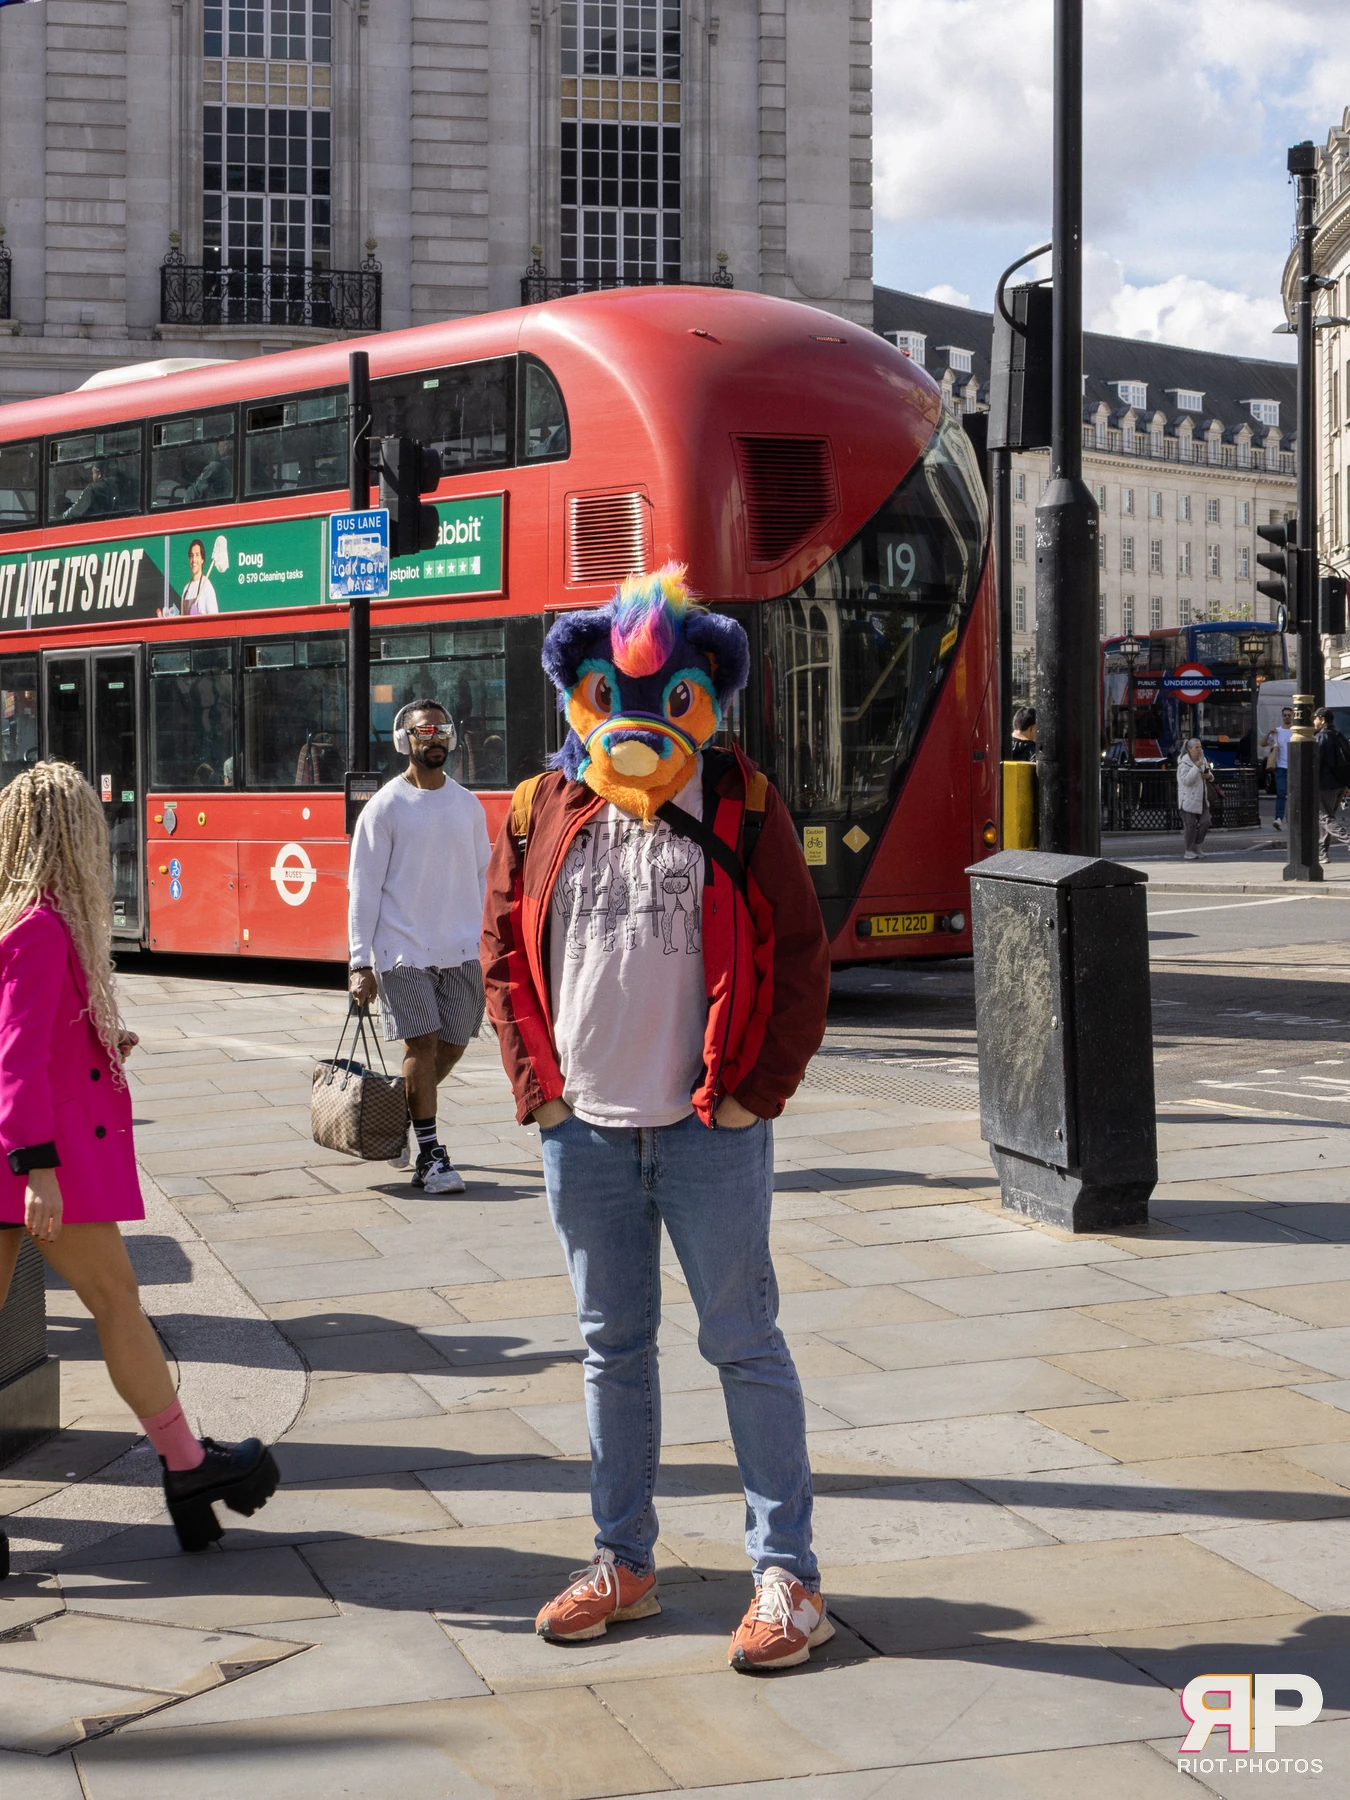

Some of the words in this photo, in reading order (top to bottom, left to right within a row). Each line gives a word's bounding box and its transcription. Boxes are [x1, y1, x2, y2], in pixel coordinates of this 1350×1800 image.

[337, 518, 355, 531] BUS
[358, 516, 381, 529] LANE
[238, 552, 263, 568] Doug
[887, 543, 916, 587] 19
[246, 573, 258, 583] 579
[259, 571, 286, 582] Cleaning
[286, 569, 304, 580] tasks
[333, 562, 358, 577] LOOK
[360, 562, 385, 575] BOTH
[14, 558, 60, 617] LIKE
[58, 553, 98, 612] IT'S
[97, 548, 144, 609] HOT
[285, 870, 302, 878] BUSES
[876, 917, 899, 933] LTZ
[902, 916, 927, 932] 1220
